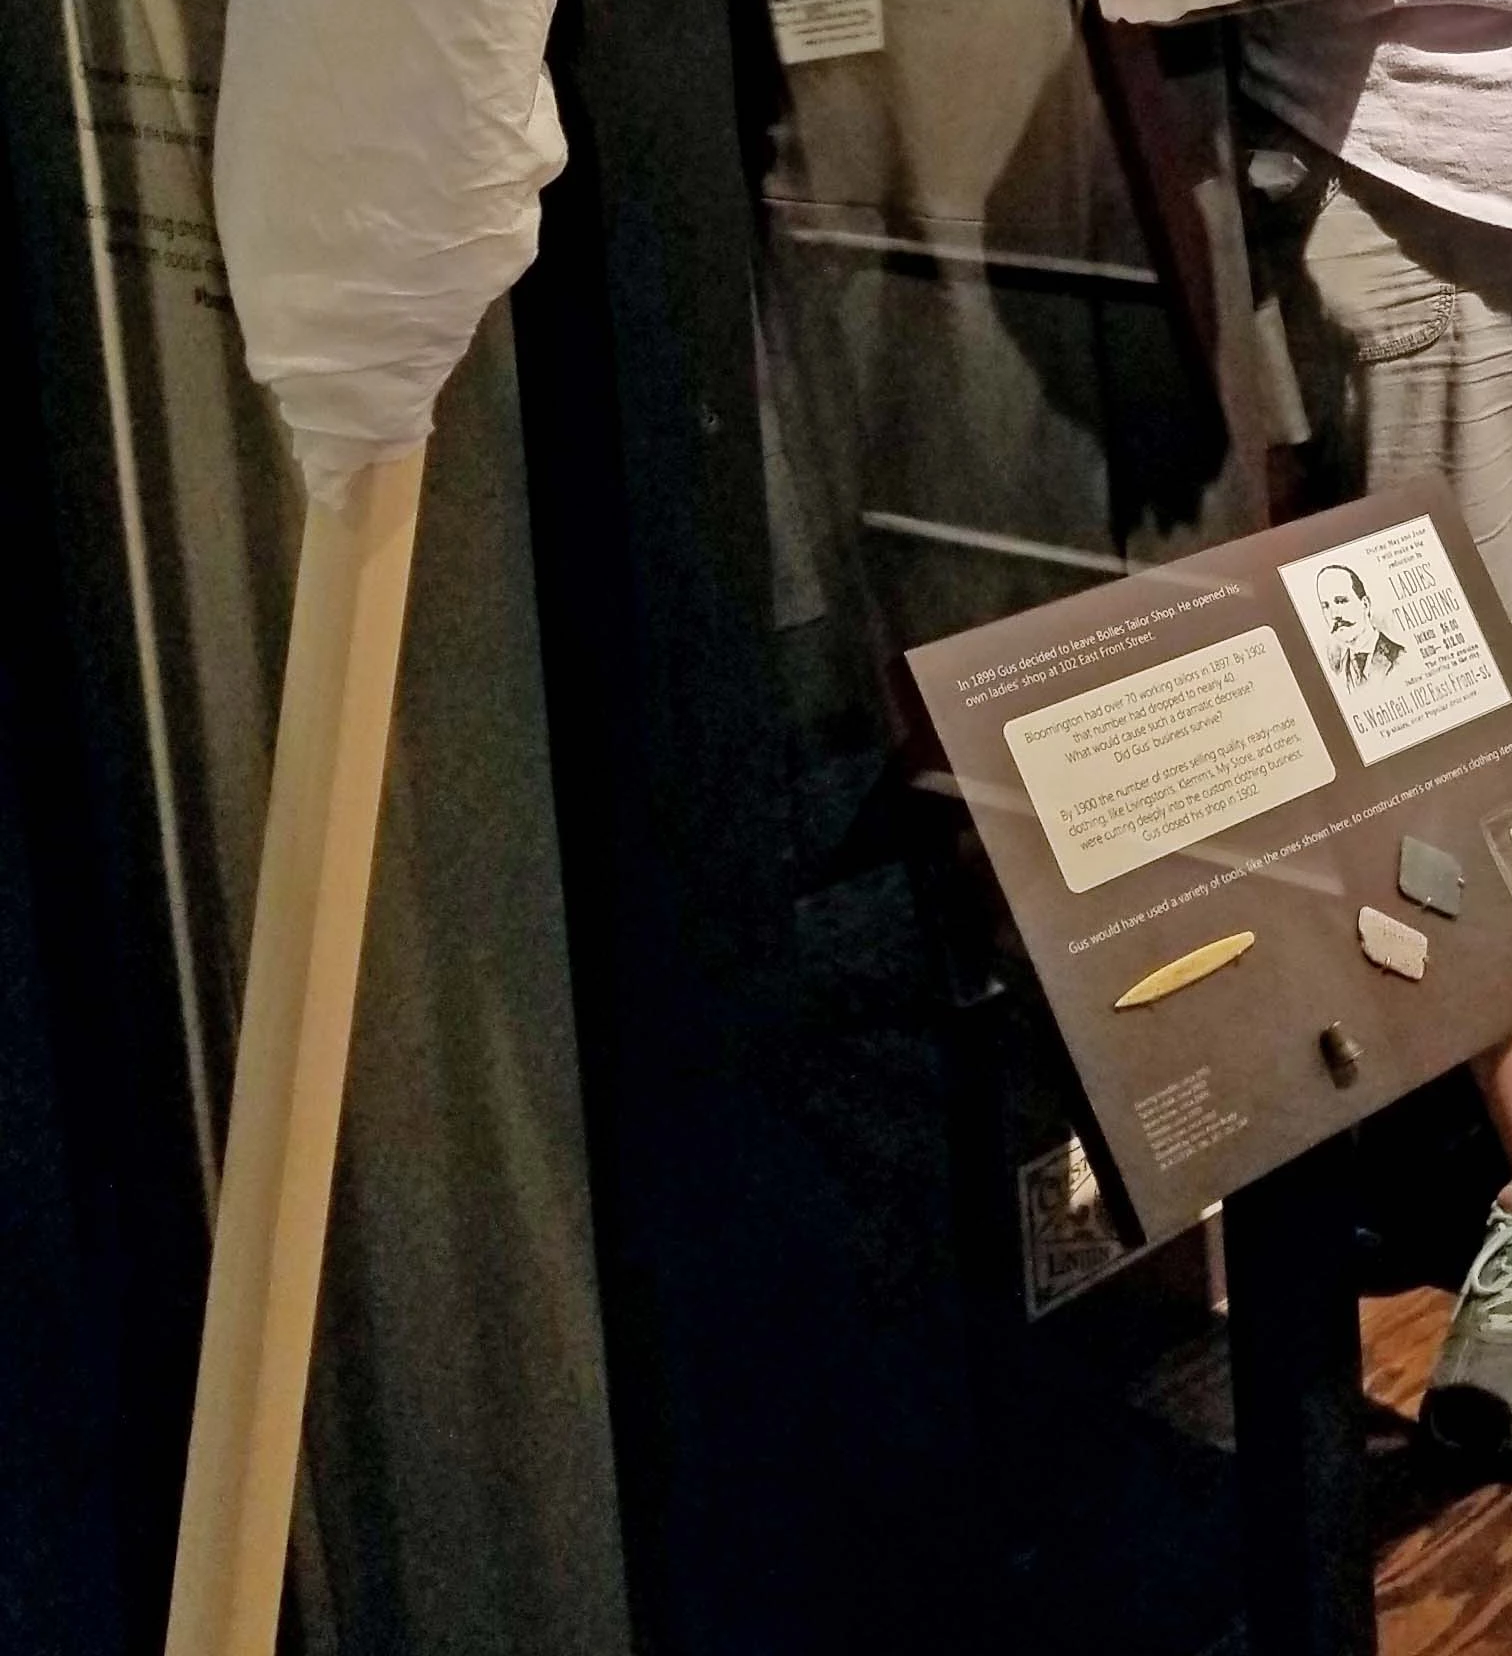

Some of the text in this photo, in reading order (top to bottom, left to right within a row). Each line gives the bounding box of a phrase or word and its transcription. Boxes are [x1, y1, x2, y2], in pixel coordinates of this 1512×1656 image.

[1389, 562, 1435, 600] LADIES'
[1392, 588, 1459, 631] TAILORING
[958, 681, 970, 691] In
[971, 669, 995, 686] 1899
[998, 664, 1017, 676] Gus
[1019, 648, 1057, 669] decided
[1058, 646, 1069, 654] to
[1070, 636, 1095, 650] leave
[1096, 625, 1124, 641] Bolles
[1125, 616, 1149, 630] Tailor
[1177, 602, 1191, 611] He
[1193, 587, 1225, 607] opened
[1225, 584, 1239, 594] his
[966, 693, 988, 706] own
[1022, 672, 1046, 686] shop
[1049, 666, 1058, 676] at
[1059, 658, 1077, 672] 102
[1078, 652, 1099, 665] East
[1100, 642, 1125, 657] Front
[1069, 939, 1089, 953] Gus
[1091, 922, 1120, 943] would
[1121, 914, 1144, 928] have
[1147, 900, 1169, 918] used
[1171, 899, 1177, 907] a
[1178, 885, 1208, 903] variety
[1210, 876, 1219, 888] of
[1246, 860, 1262, 870] like
[1264, 852, 1278, 864] the
[1280, 842, 1301, 856] ones
[1302, 829, 1329, 846] shown
[1352, 814, 1361, 823] to
[1363, 795, 1400, 818] construct
[1425, 780, 1432, 790] or
[1469, 751, 1499, 769] clothing
